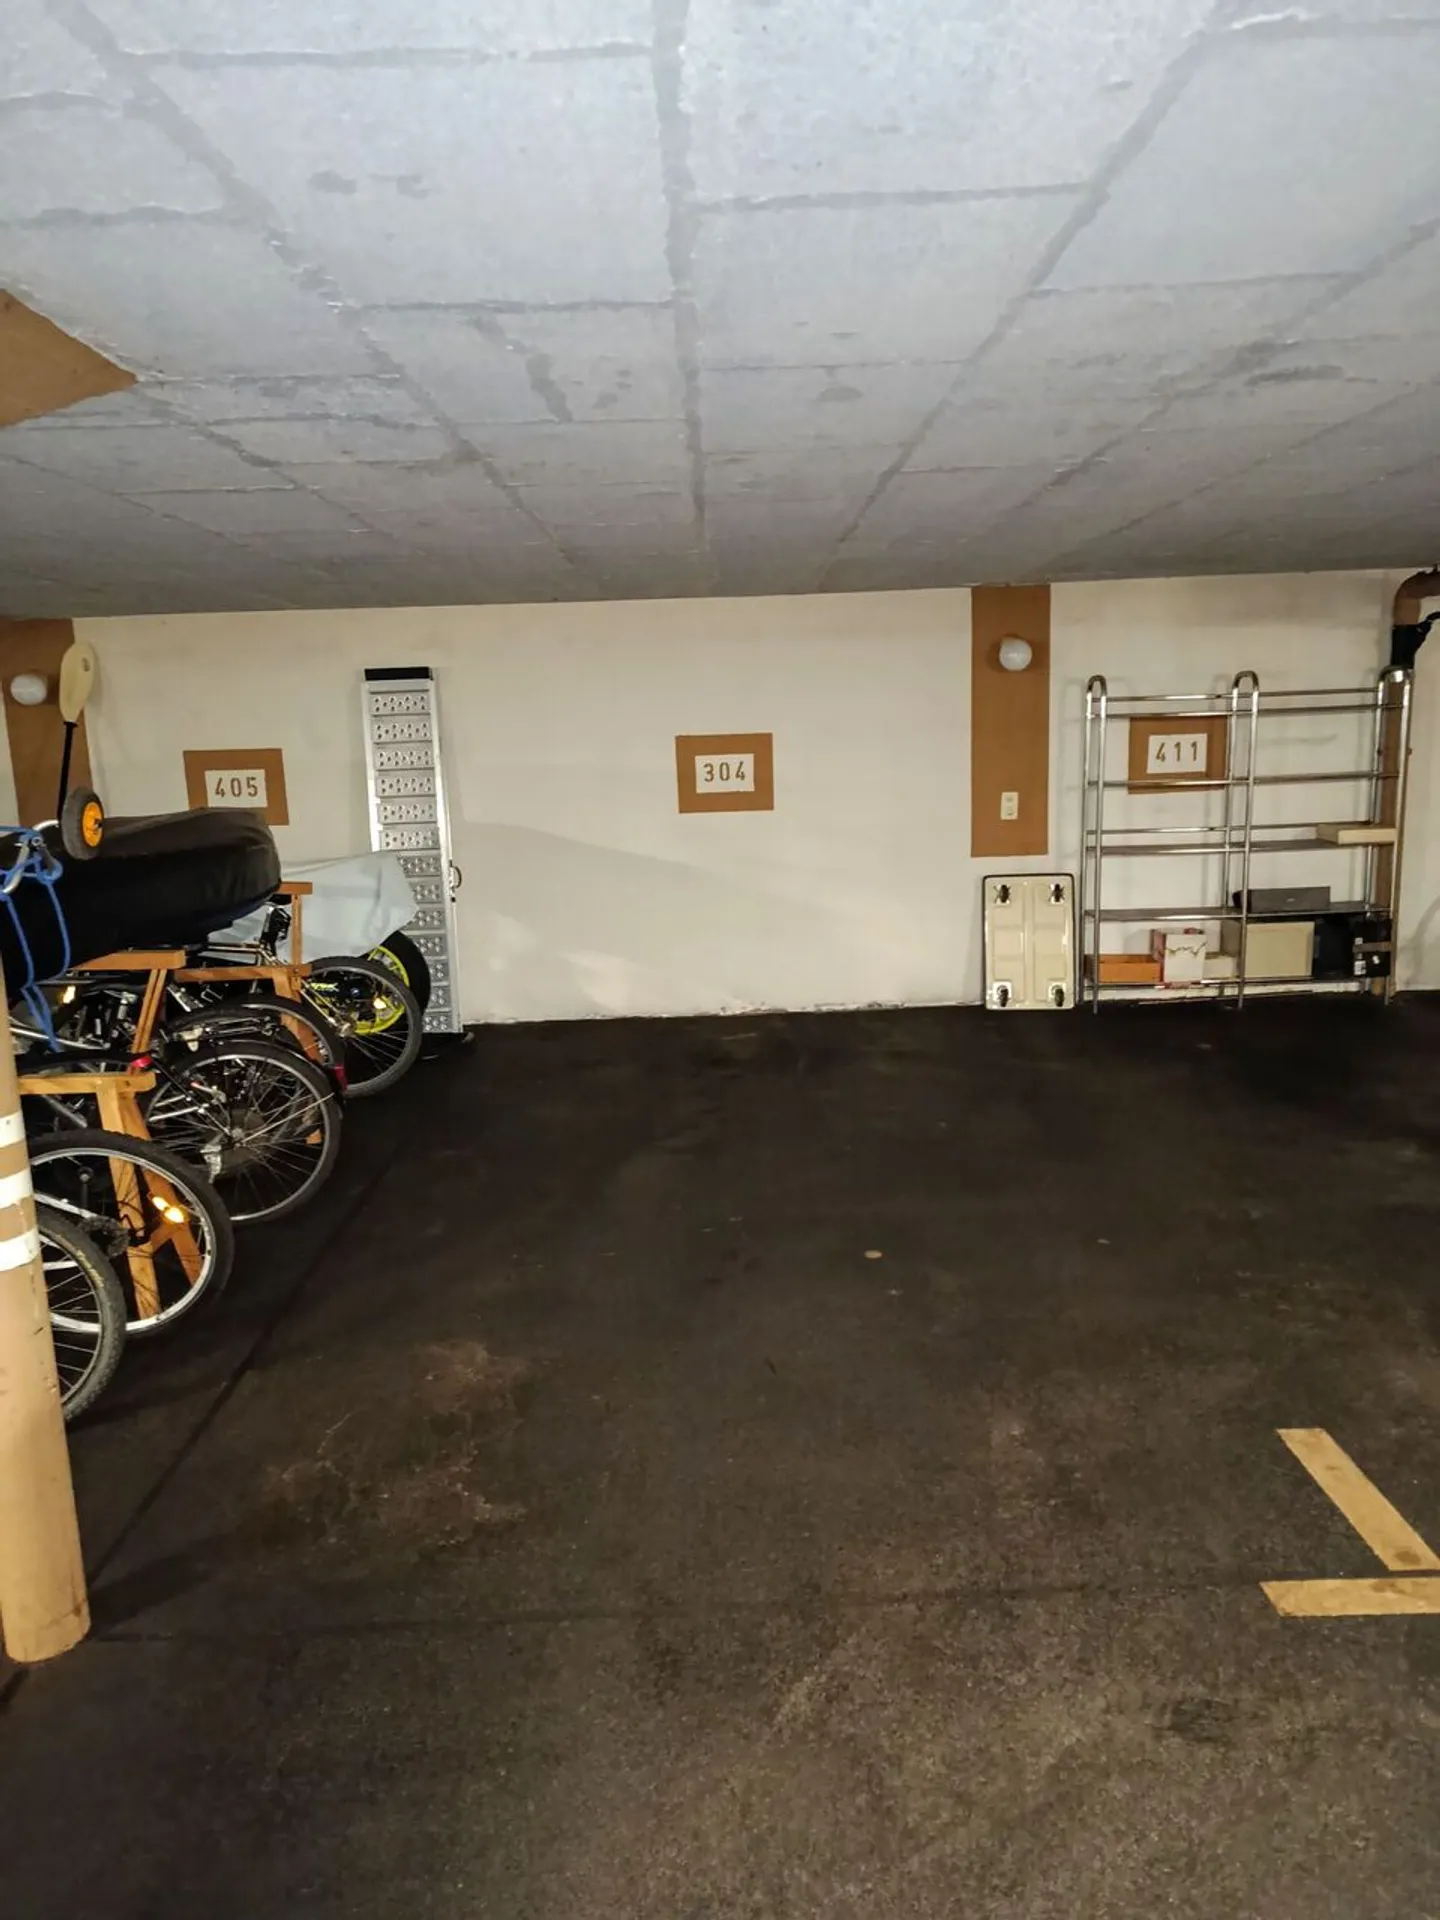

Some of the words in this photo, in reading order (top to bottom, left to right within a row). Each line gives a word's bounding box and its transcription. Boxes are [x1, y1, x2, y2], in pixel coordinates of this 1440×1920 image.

[1156, 741, 1198, 762] 411
[703, 760, 746, 783] 304
[215, 776, 258, 798] 405
